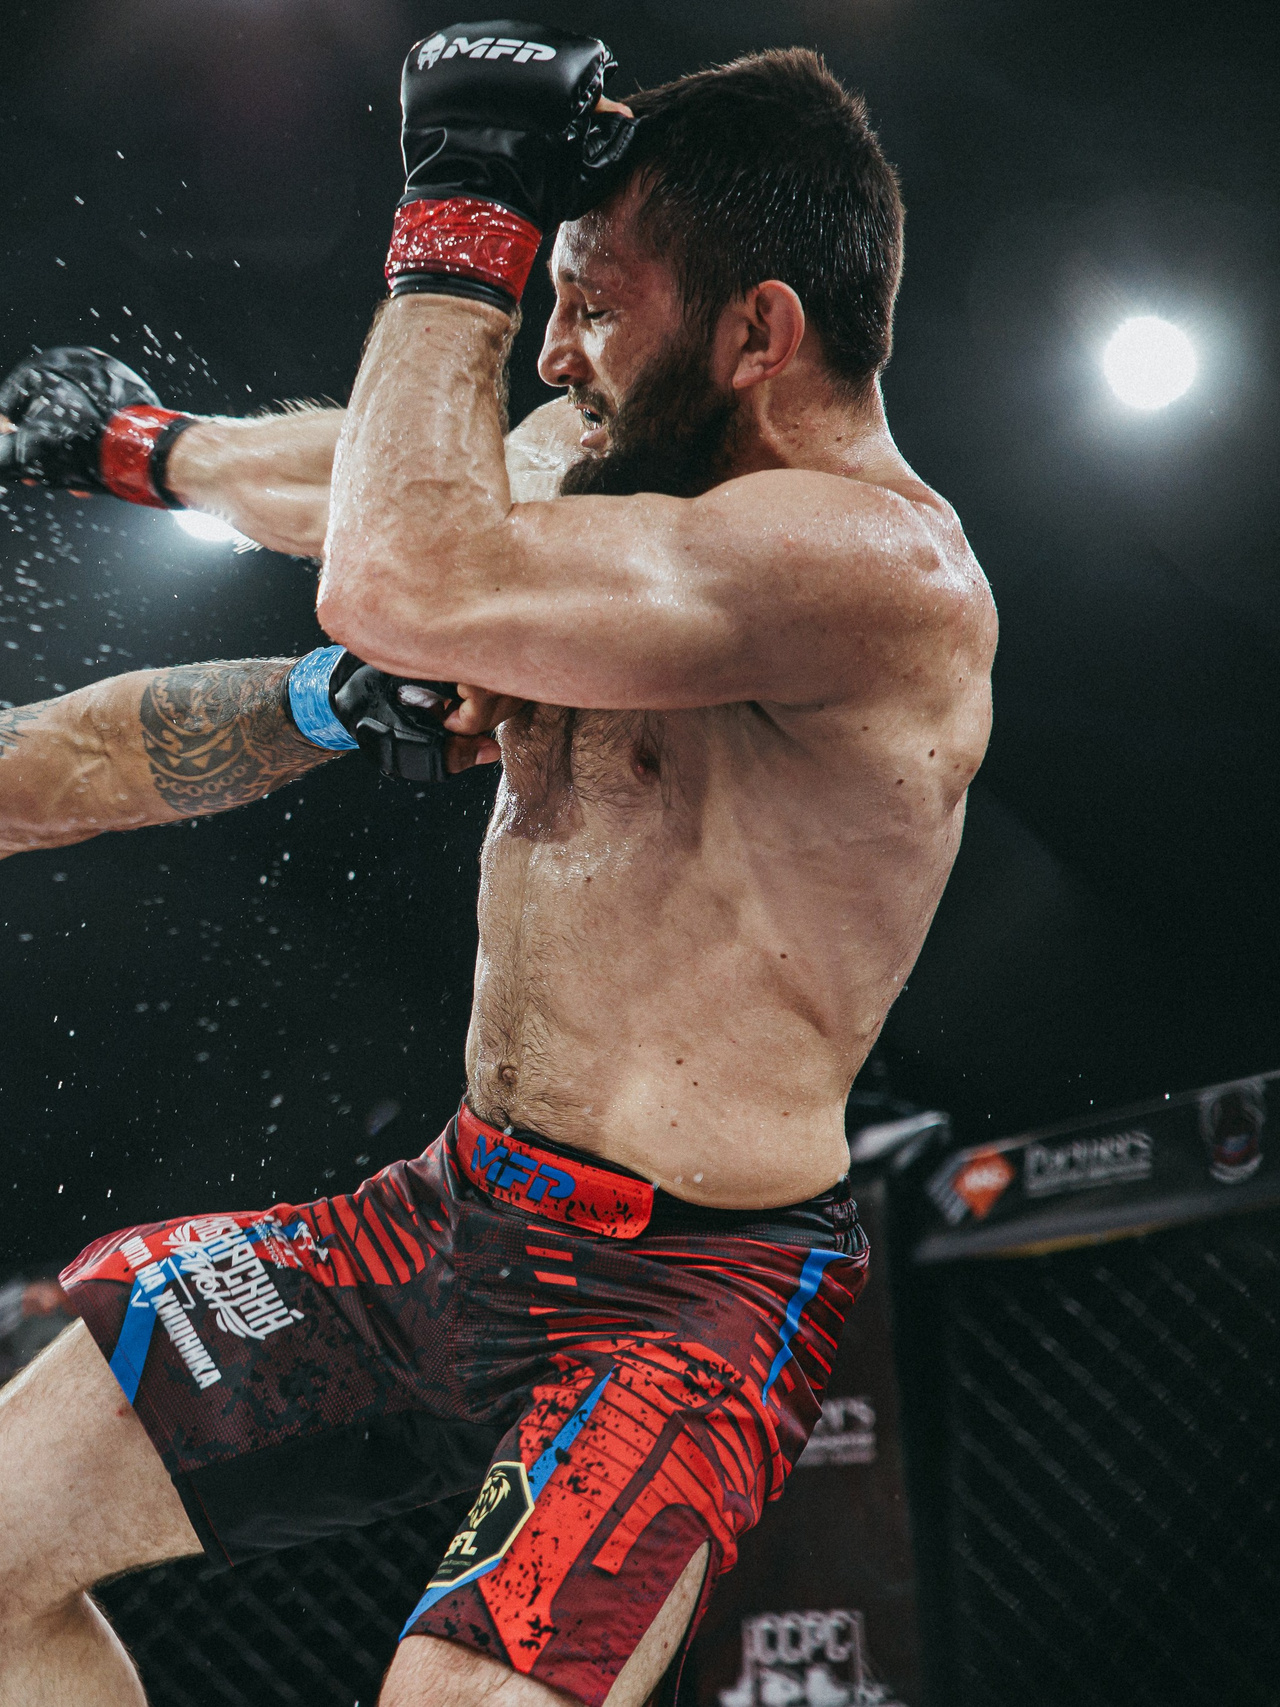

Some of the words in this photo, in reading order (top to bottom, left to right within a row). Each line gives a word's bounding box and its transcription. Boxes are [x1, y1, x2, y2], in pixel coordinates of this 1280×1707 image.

[441, 36, 557, 63] MFP
[470, 1133, 576, 1202] MFP
[135, 1261, 167, 1294] НА
[150, 1287, 222, 1391] ХИЩНИКА
